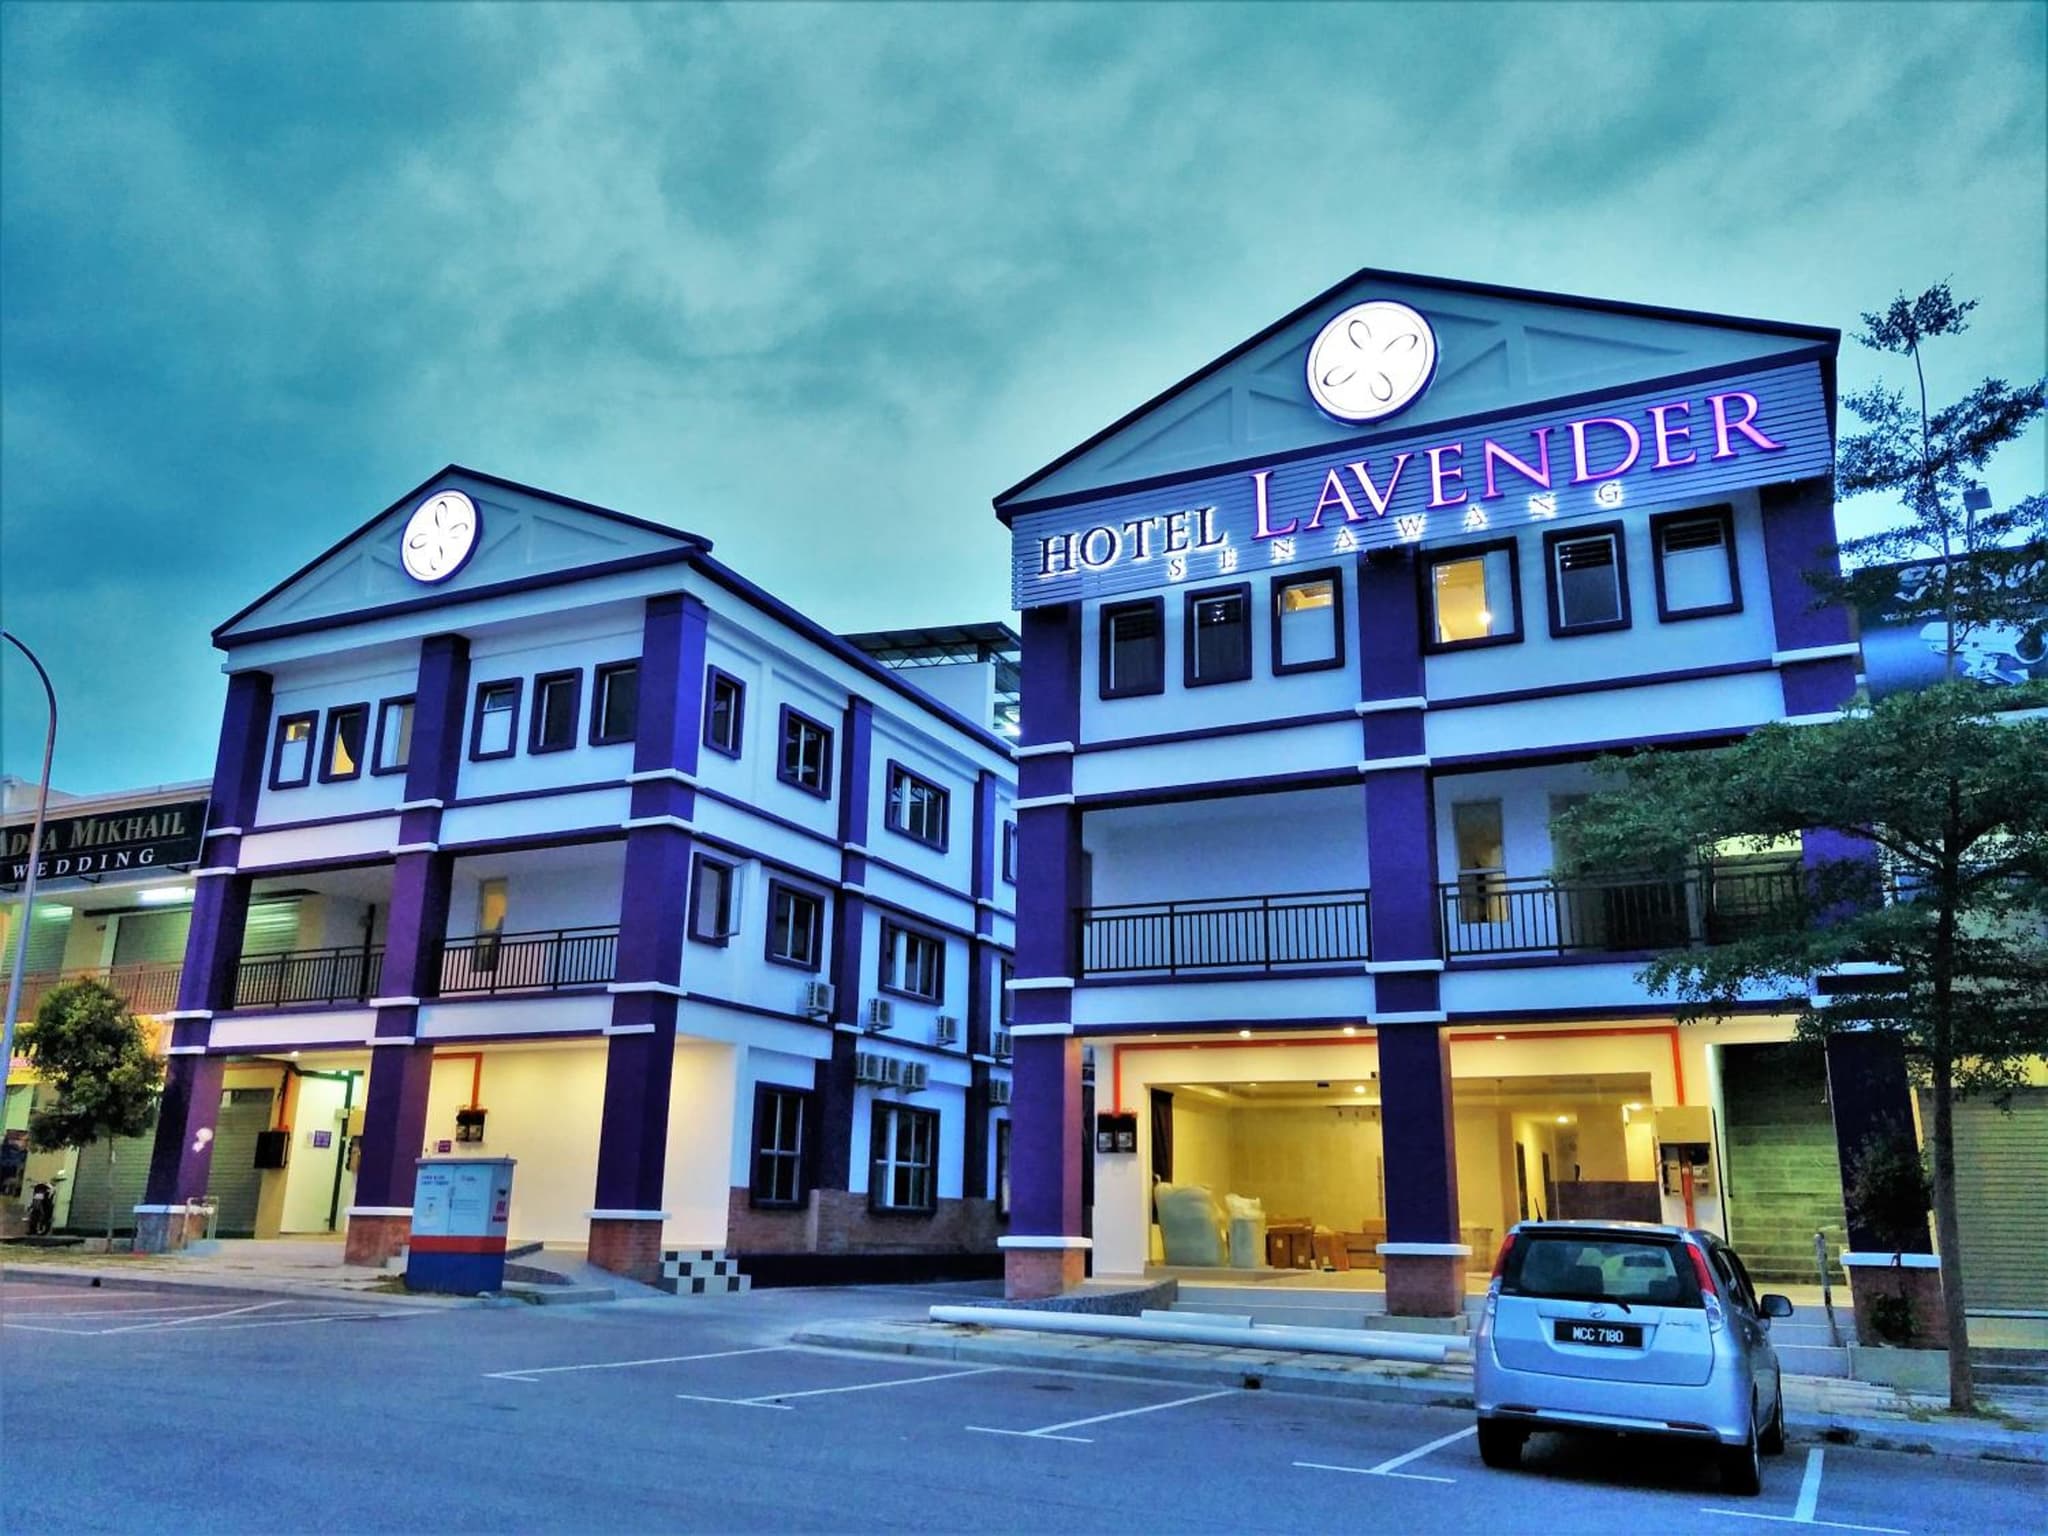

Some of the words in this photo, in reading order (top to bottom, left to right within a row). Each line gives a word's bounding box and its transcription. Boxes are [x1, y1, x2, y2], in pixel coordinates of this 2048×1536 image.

[1037, 505, 1227, 576] HOTEL
[1249, 391, 1787, 542] LAVENDER
[1168, 481, 1623, 577] SENAWANG
[69, 812, 185, 849] MIKHAIL
[13, 848, 155, 880] WEDDING
[1598, 1328, 1625, 1344] 7180
